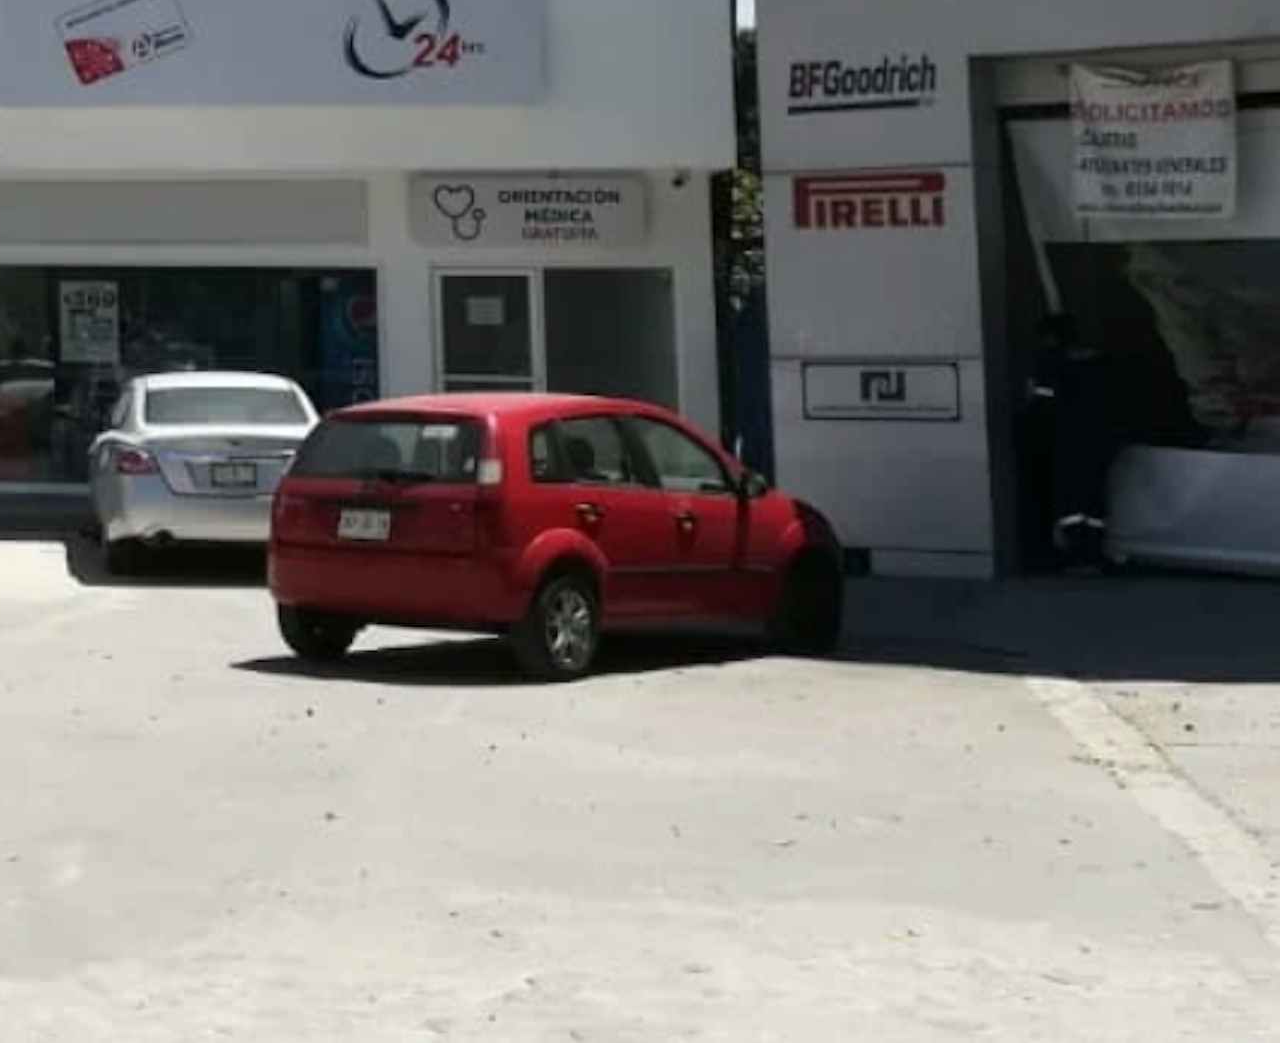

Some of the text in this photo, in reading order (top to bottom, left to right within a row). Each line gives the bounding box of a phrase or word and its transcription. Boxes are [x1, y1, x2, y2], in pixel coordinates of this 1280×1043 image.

[413, 31, 460, 68] 24
[788, 53, 937, 99] BFGoodrich
[497, 187, 621, 204] ORIENTACIÓN
[794, 172, 945, 229] PIRELLI
